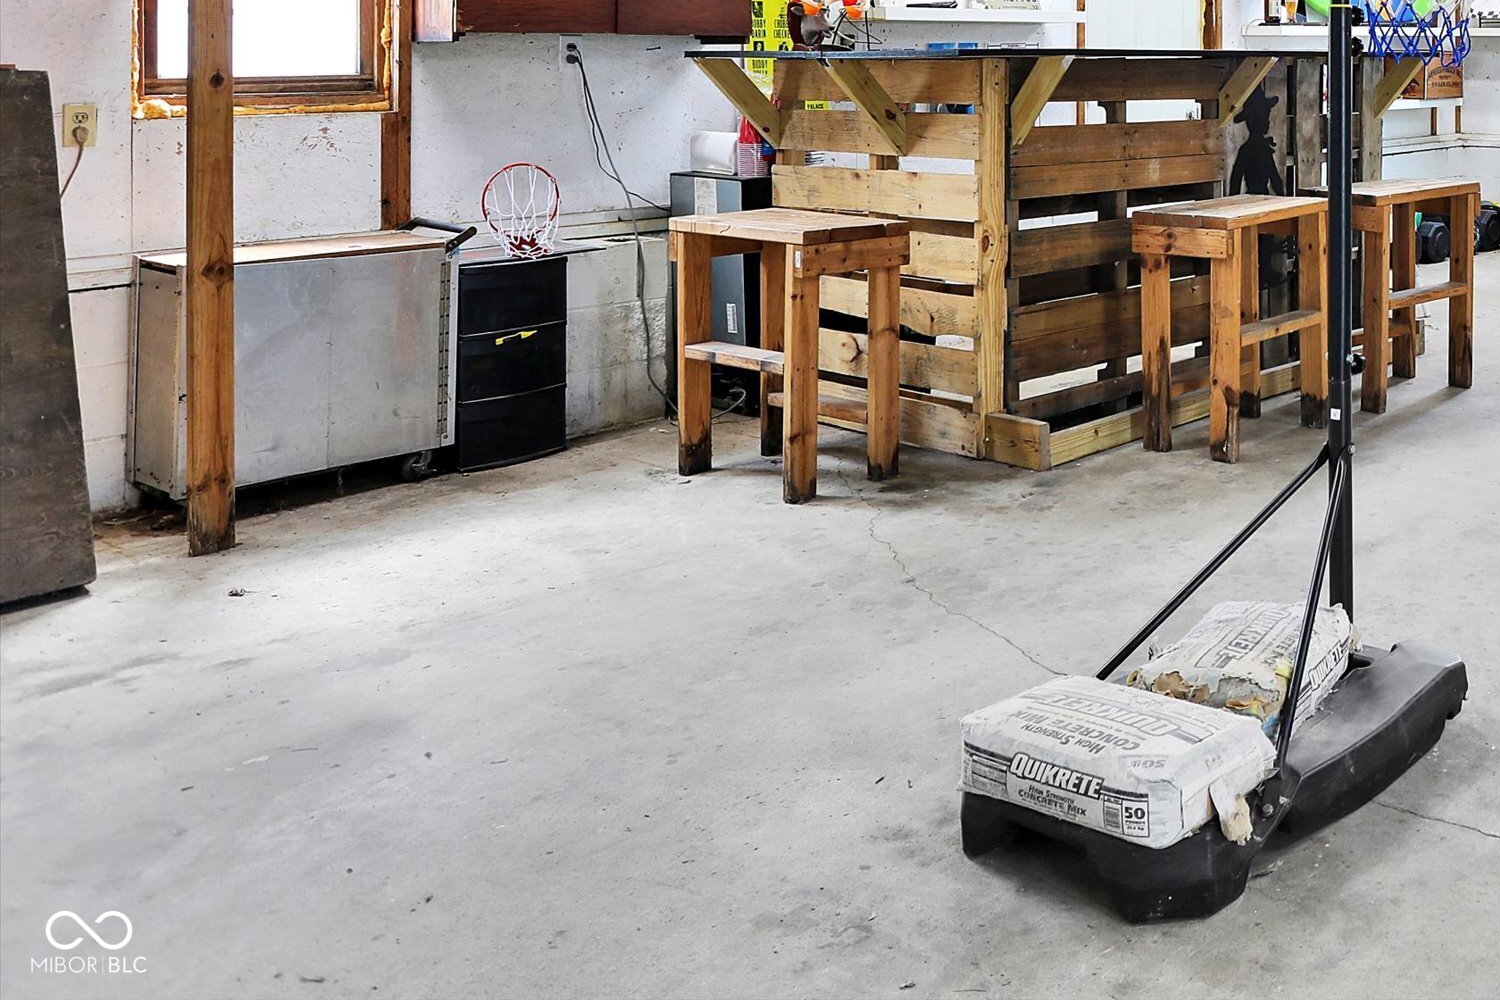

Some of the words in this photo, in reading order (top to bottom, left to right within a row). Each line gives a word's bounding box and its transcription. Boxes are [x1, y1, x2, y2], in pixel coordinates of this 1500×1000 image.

[1050, 718, 1142, 751] CONCRETE
[1009, 752, 1104, 800] QUIKRETE
[1018, 789, 1065, 811] CONCRETE
[1066, 803, 1087, 817] MIX
[1124, 806, 1146, 819] 50
